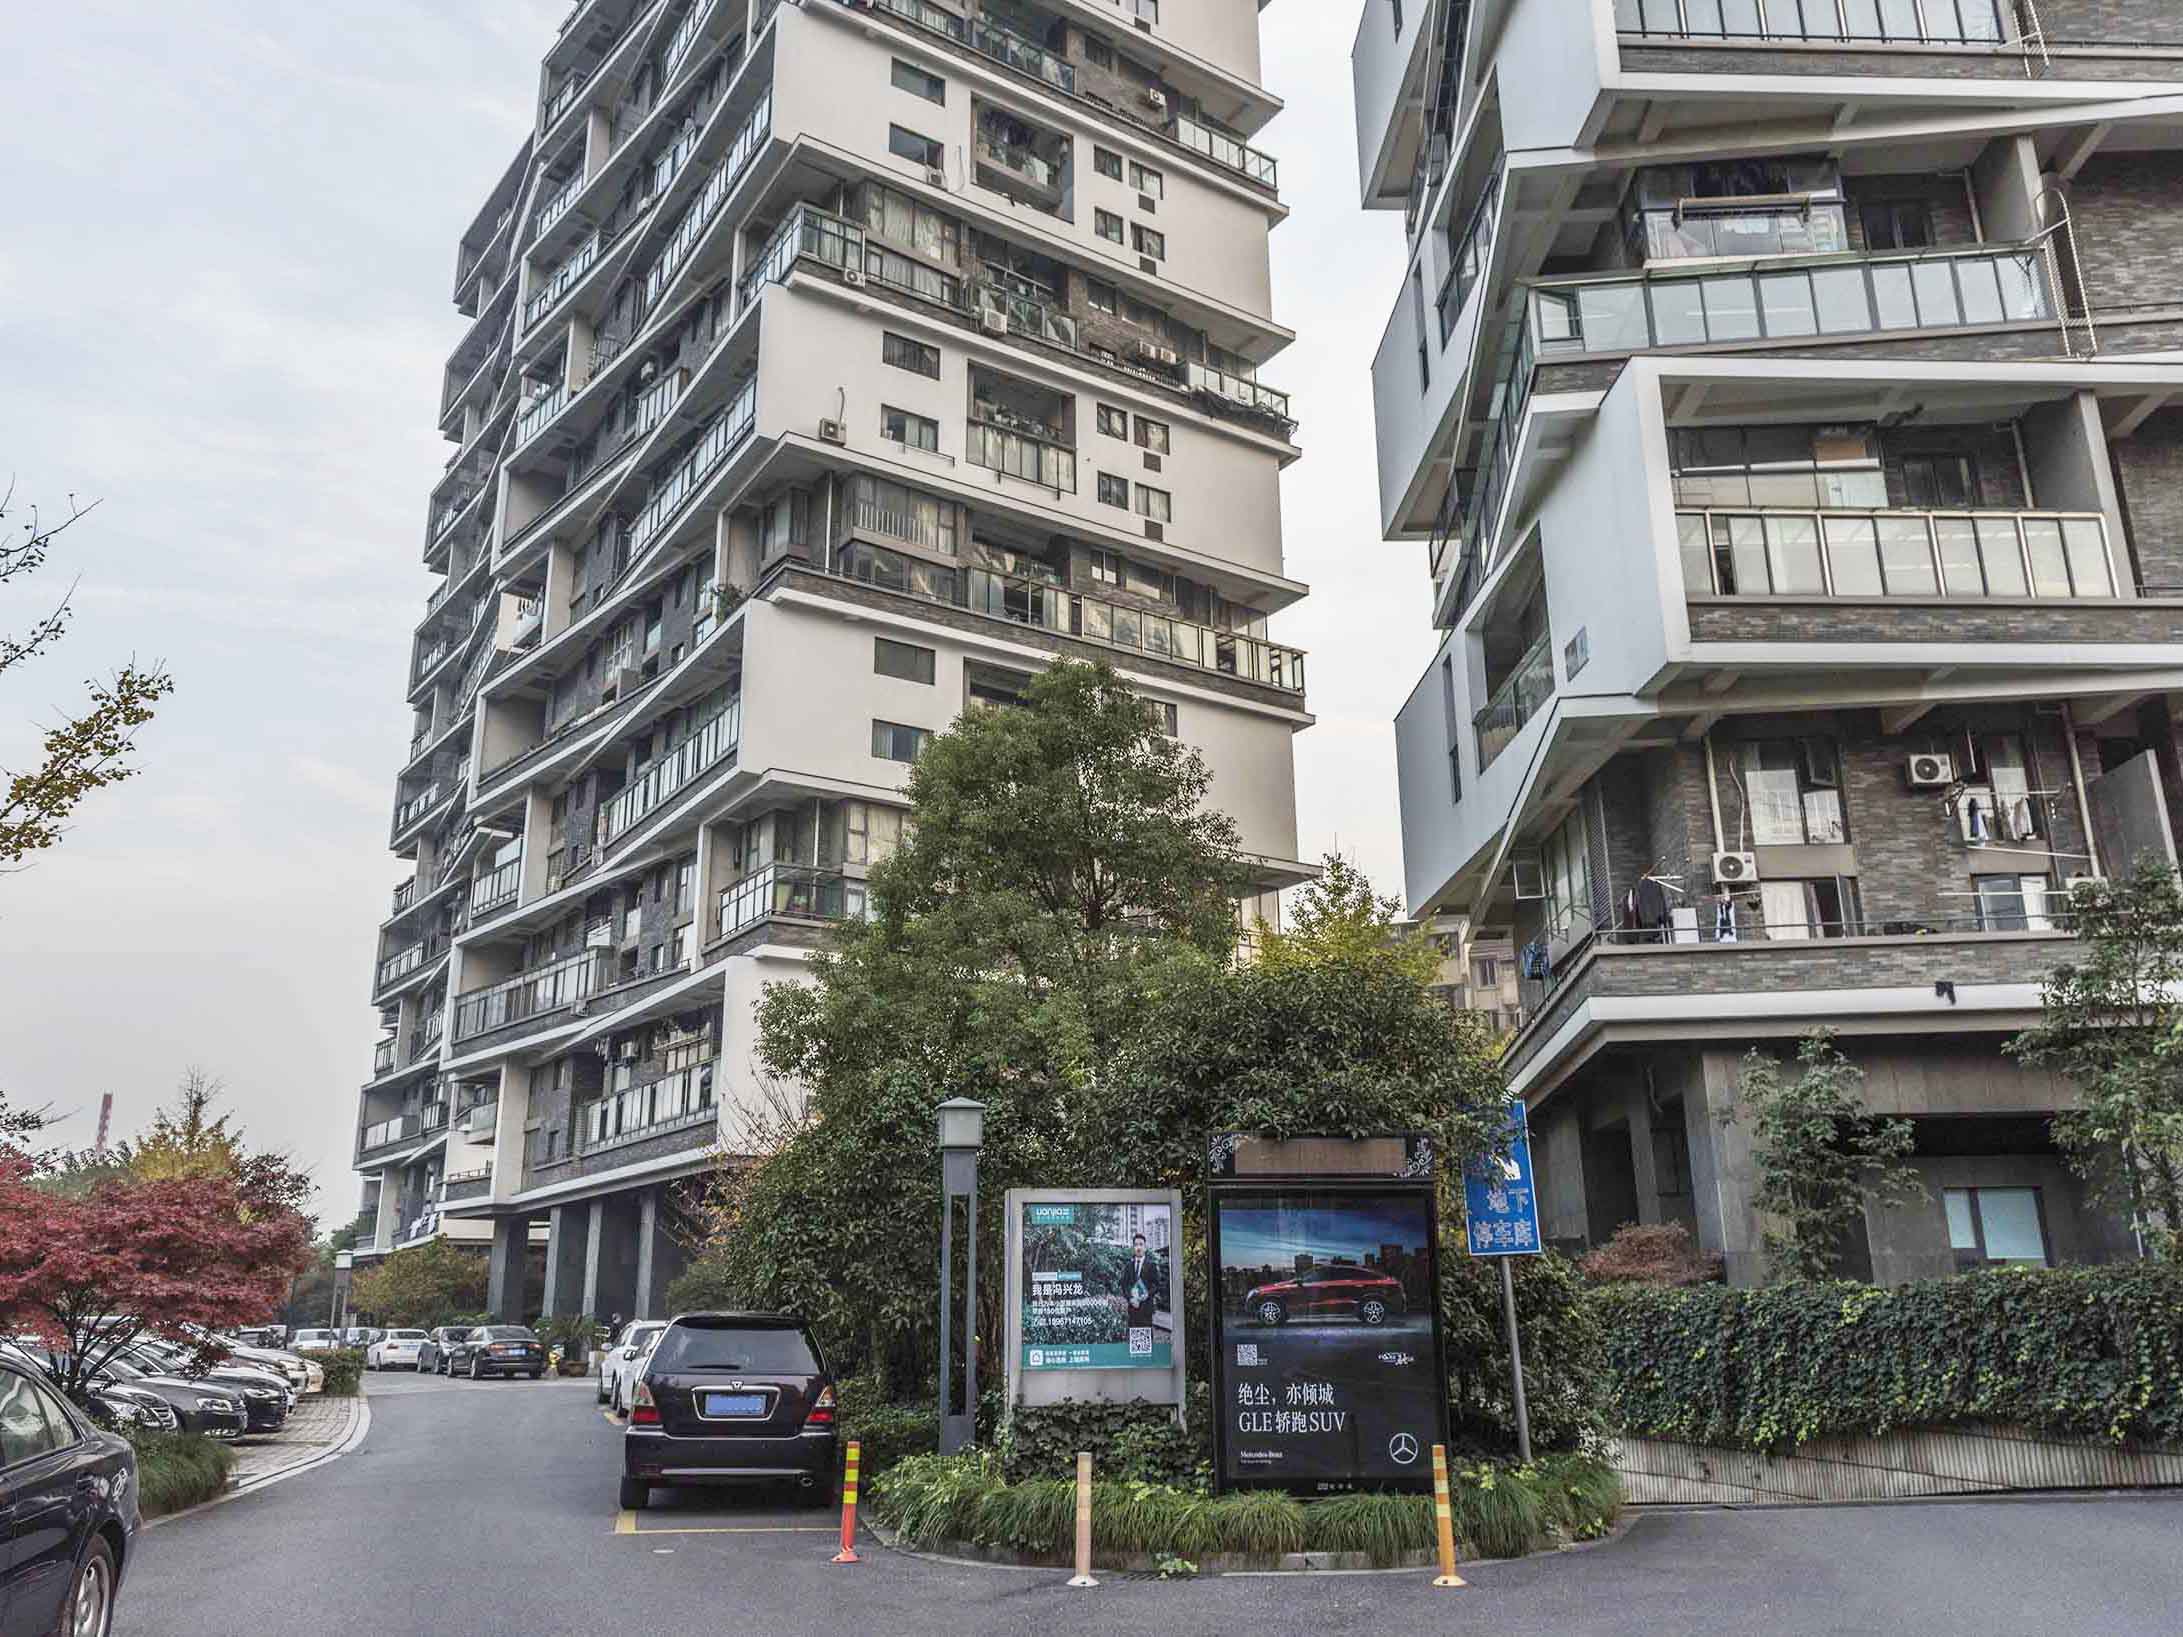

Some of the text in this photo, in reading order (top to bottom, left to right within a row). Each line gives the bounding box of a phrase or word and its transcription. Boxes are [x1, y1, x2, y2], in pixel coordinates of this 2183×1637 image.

[1486, 1188, 1529, 1214] 地下
[1473, 1218, 1534, 1248] 停车库
